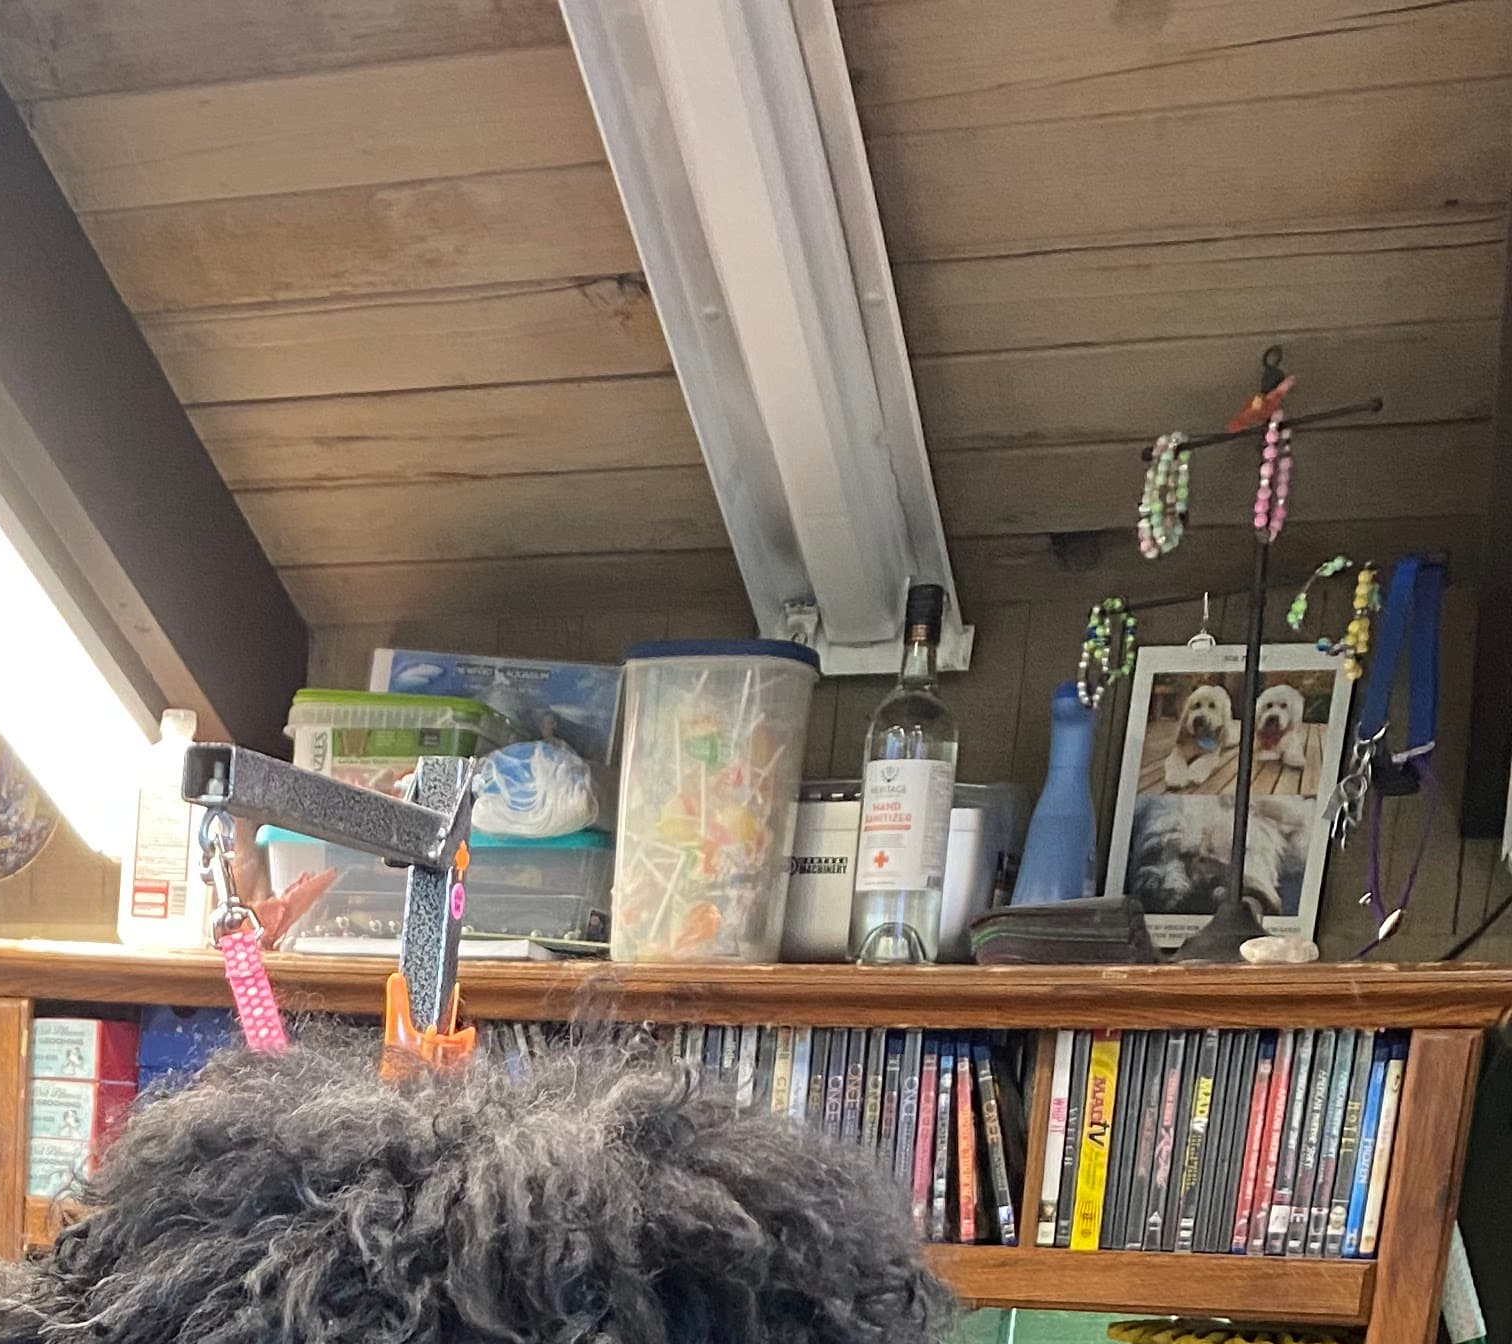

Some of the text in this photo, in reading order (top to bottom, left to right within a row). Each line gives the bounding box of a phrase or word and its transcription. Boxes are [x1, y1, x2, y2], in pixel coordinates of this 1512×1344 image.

[873, 802, 901, 811] HAND
[864, 813, 912, 824] SANITIZER
[799, 865, 848, 874] MACHINERY
[1313, 1070, 1329, 1110] AMERICAN
[1359, 1138, 1376, 1184] FROZEN
